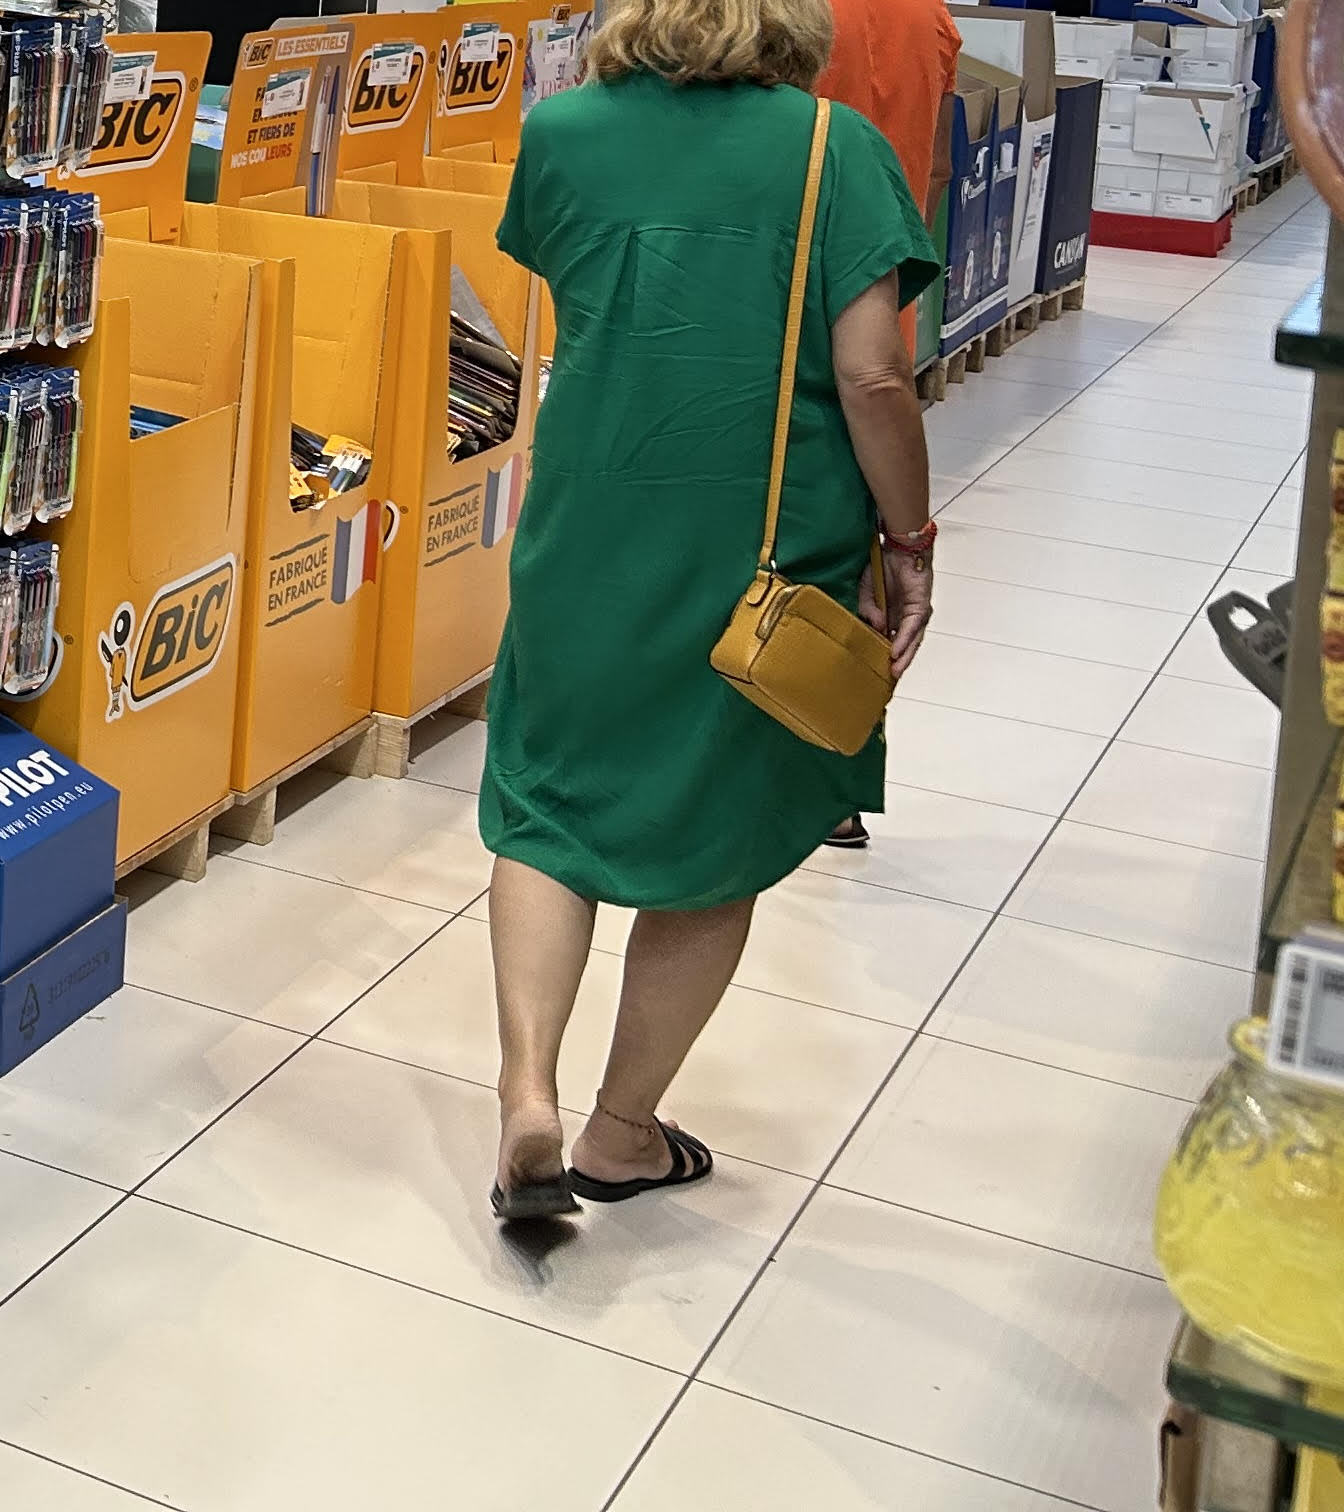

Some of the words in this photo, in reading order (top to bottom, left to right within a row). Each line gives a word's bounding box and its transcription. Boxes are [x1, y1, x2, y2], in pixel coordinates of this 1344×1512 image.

[277, 40, 294, 57] LES
[294, 35, 347, 56] ESSENTIELS
[246, 127, 259, 145] ET
[282, 122, 297, 138] DE
[230, 151, 248, 169] NOS
[248, 142, 293, 165] COULEURS
[426, 494, 480, 534] FABRIQUE
[425, 531, 441, 554] EN
[440, 516, 479, 549] FRANCE
[268, 546, 329, 590] FABRIQUE
[267, 591, 283, 612] EN
[282, 569, 328, 607] FRANCE
